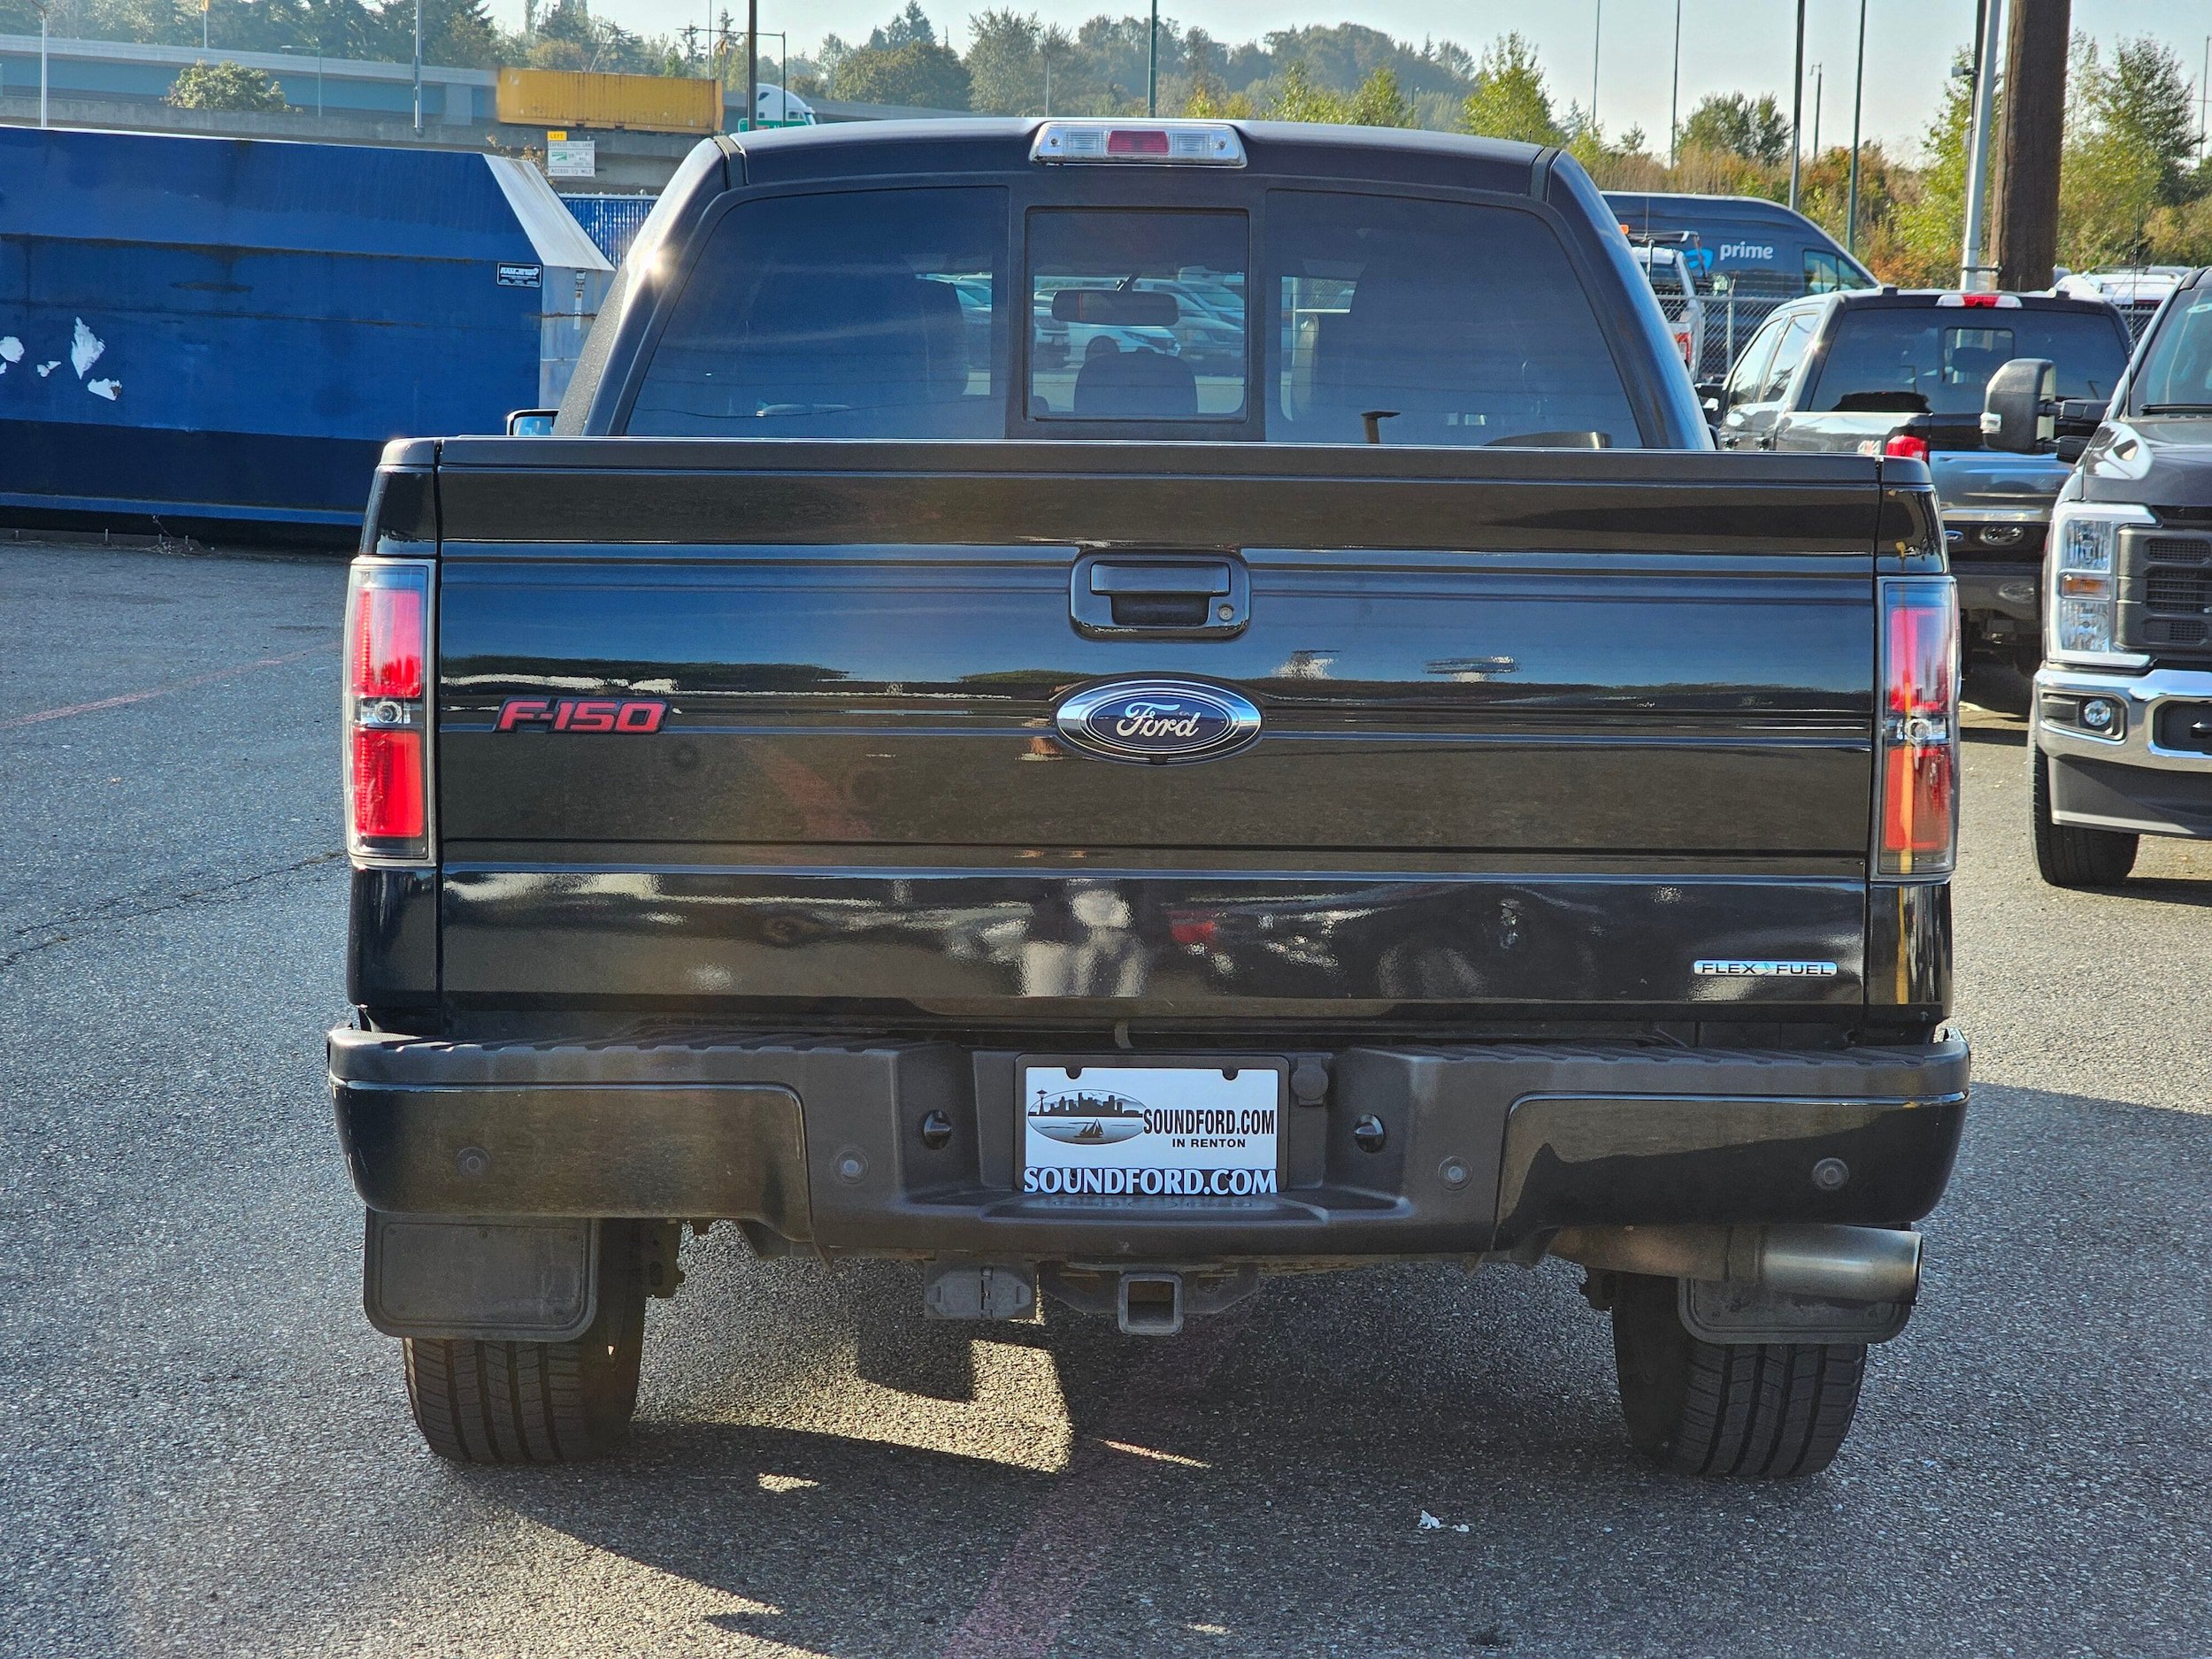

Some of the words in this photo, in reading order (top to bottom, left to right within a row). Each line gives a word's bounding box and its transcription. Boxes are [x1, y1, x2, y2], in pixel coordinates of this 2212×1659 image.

[1719, 241, 1774, 261] prime
[498, 701, 666, 733] F-150
[1116, 702, 1202, 738] Ford
[1701, 964, 1757, 974] FLEX
[1776, 964, 1832, 975] FUEL
[1142, 1109, 1275, 1134] SOUNDFORD.COM
[1171, 1138, 1186, 1148] IN
[1191, 1138, 1246, 1148] RENTON
[1024, 1167, 1278, 1194] SOUNDFORD.COM
